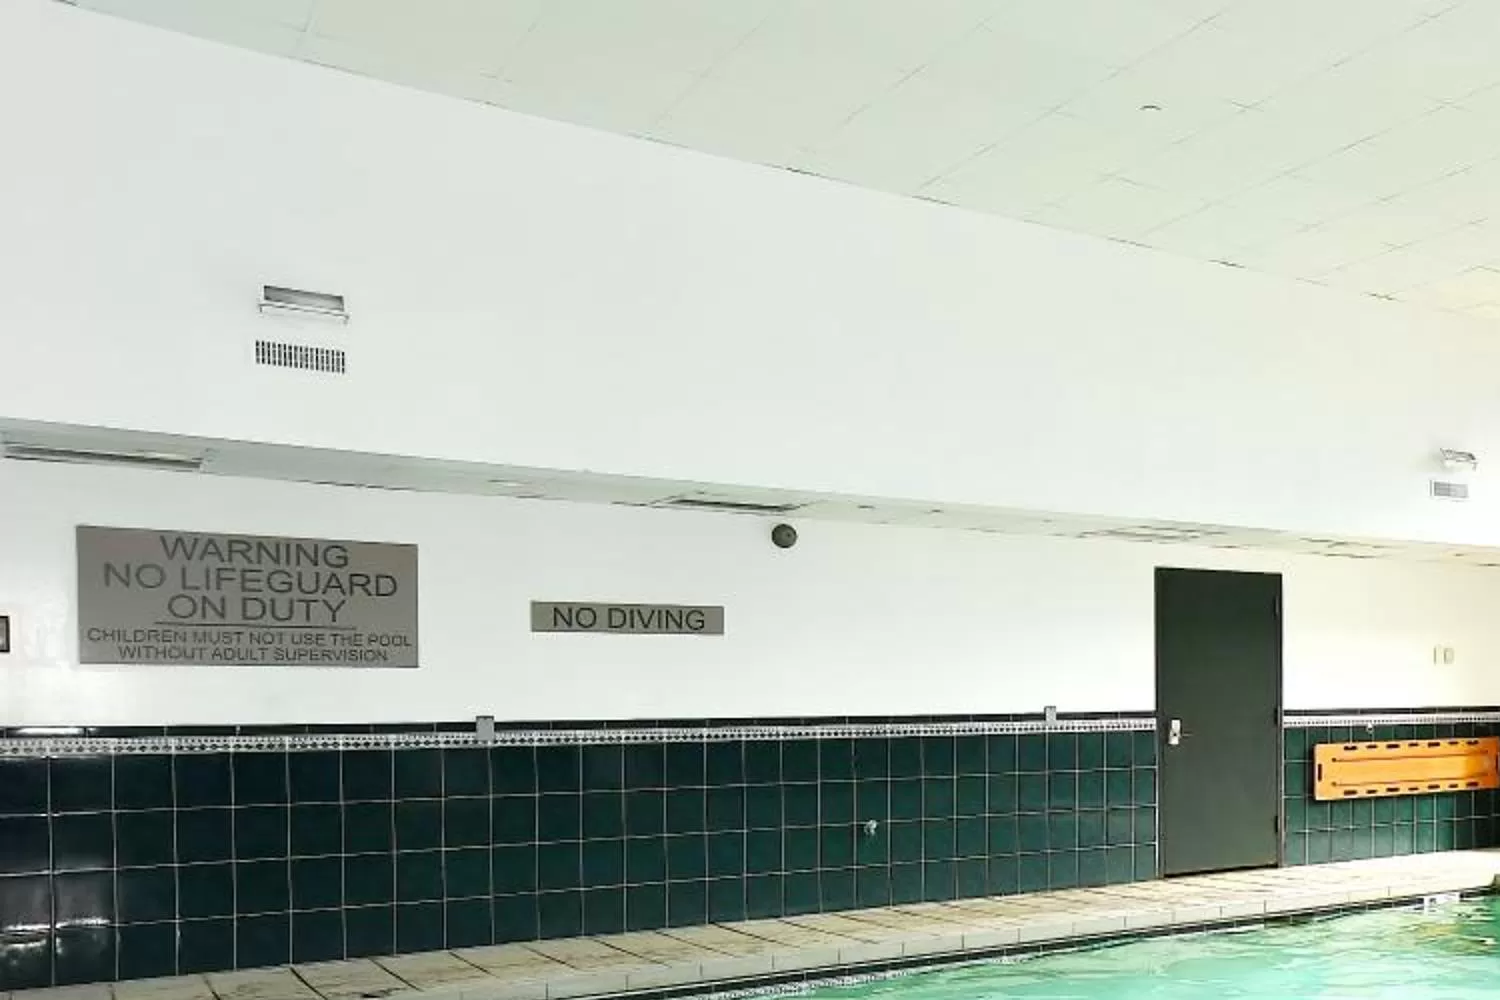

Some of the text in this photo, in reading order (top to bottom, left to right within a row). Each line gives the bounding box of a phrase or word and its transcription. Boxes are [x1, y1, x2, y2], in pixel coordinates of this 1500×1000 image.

[159, 535, 349, 569] WARNING
[103, 561, 398, 597] NO LIFEGUARD
[167, 593, 347, 623] ON DUTY
[552, 607, 705, 631] NO DIVING
[87, 627, 412, 647] CHILDREN MUST NOT USE THE POOL
[118, 645, 389, 662] WITHOUT ADULT SUPERVISION
